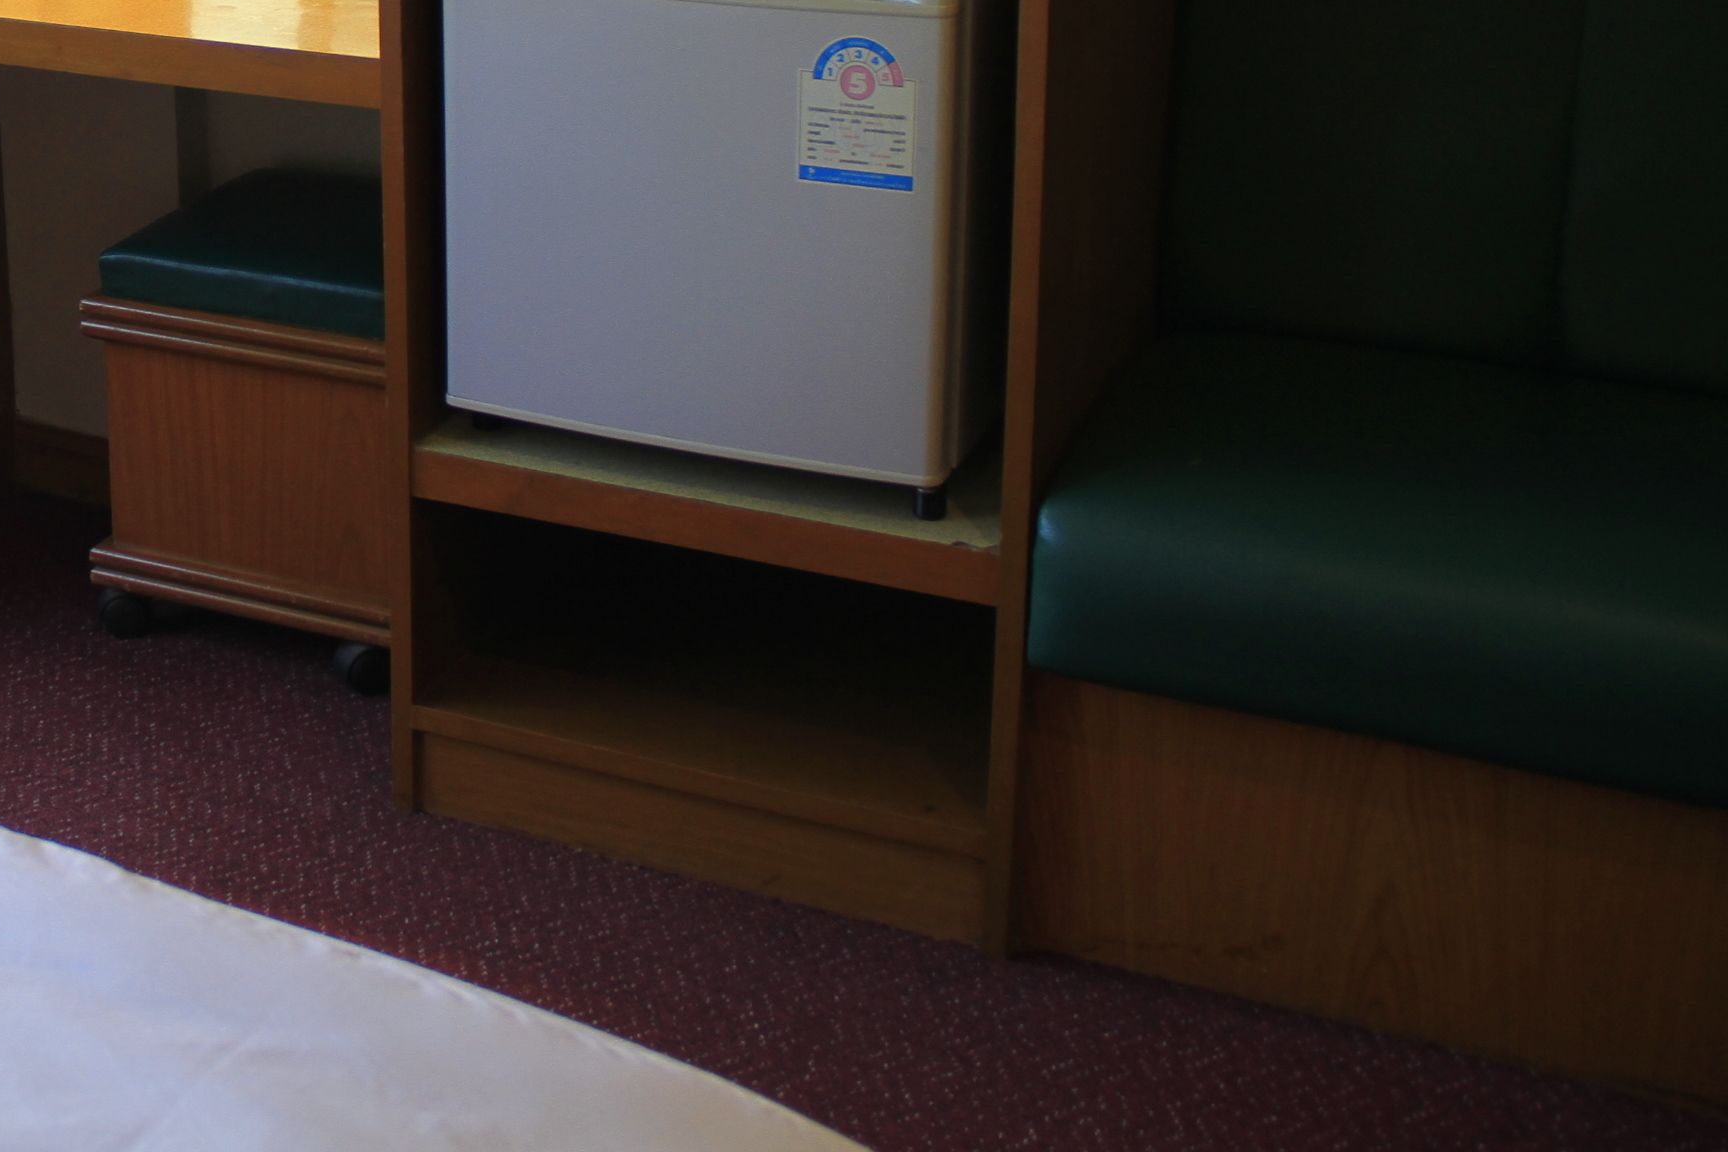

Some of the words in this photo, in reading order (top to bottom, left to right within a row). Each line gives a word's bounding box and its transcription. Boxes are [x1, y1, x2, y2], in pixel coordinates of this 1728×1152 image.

[827, 67, 834, 77] 1
[836, 53, 846, 63] 2
[854, 49, 864, 59] 3
[870, 56, 880, 65] 4
[881, 71, 890, 81] 5
[847, 71, 867, 95] 5
